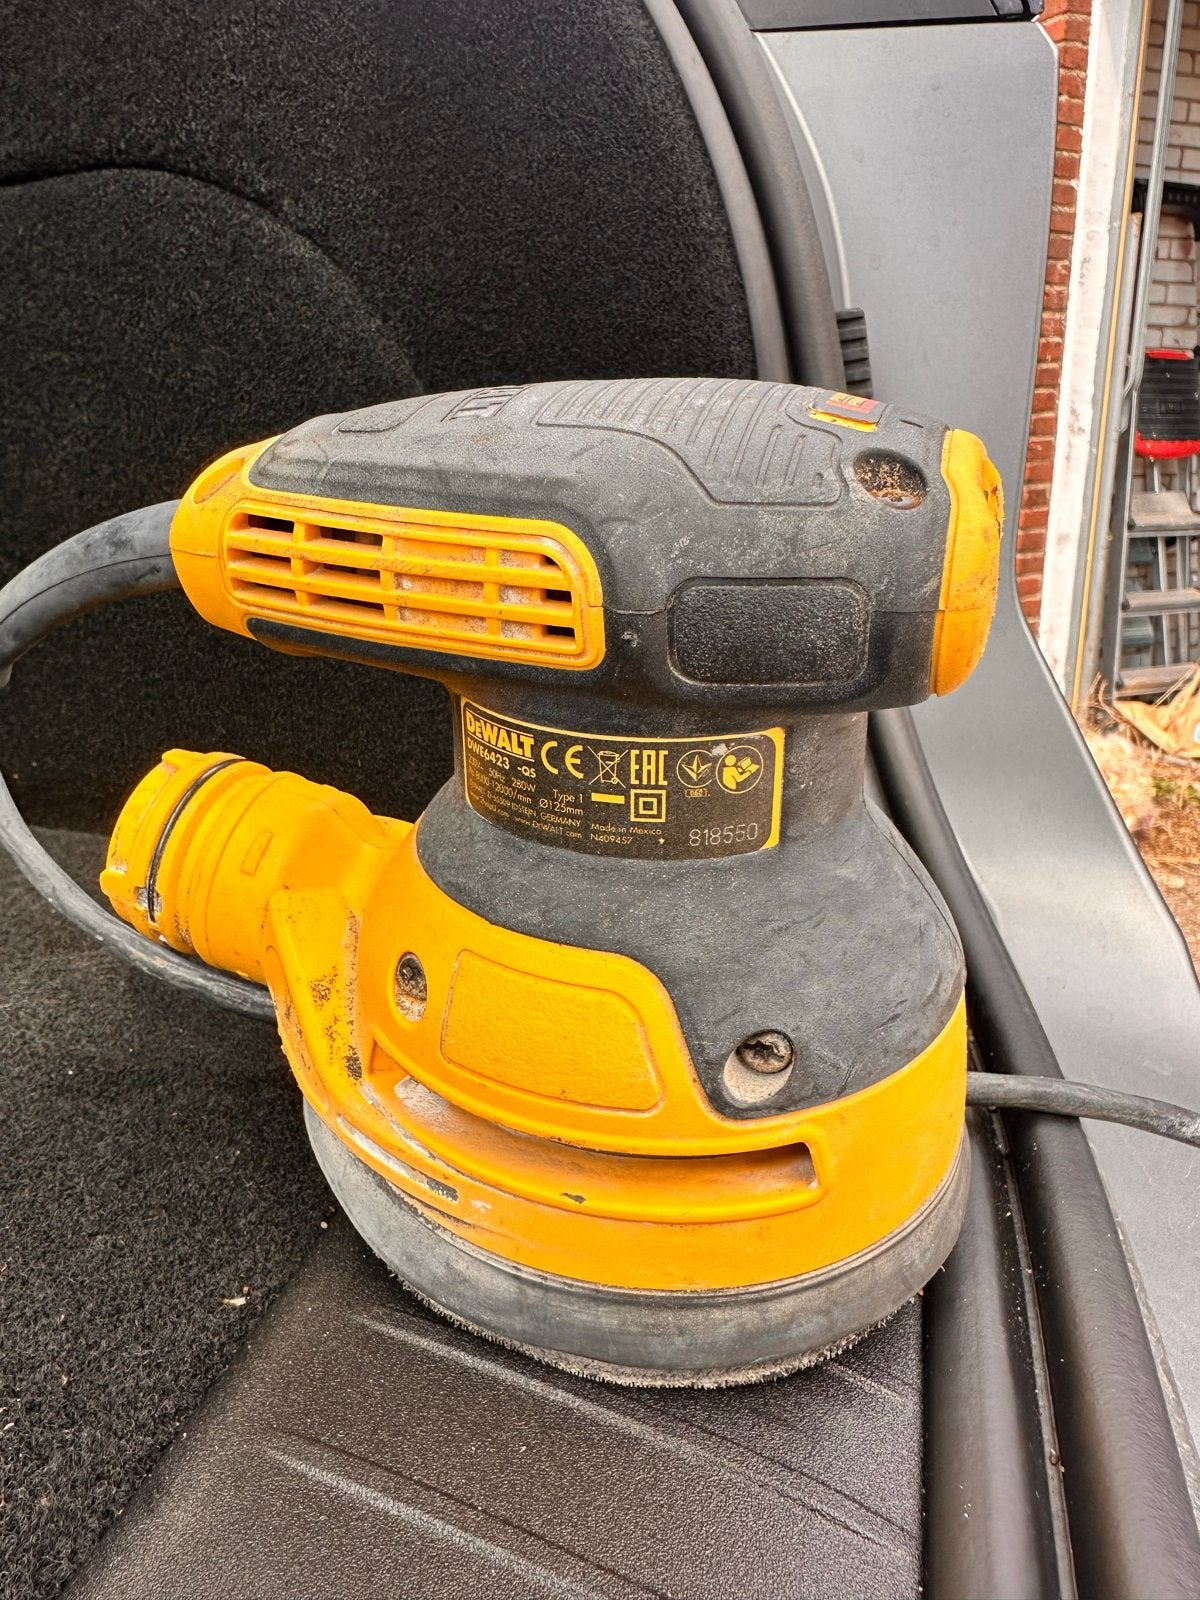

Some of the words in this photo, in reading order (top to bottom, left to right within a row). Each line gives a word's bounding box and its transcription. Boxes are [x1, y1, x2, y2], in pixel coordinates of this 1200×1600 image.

[467, 736, 510, 770] DWE6423
[541, 740, 585, 780] CE
[630, 749, 669, 786] EAC
[511, 777, 536, 793] 280W
[552, 788, 576, 804] Type
[579, 793, 584, 804] 1
[539, 798, 584, 816] Ø125mm
[540, 811, 581, 828] GERMANY
[590, 822, 616, 833] Made
[629, 827, 662, 836] Mexico
[689, 822, 758, 847] 818550
[590, 833, 633, 845] N409457
